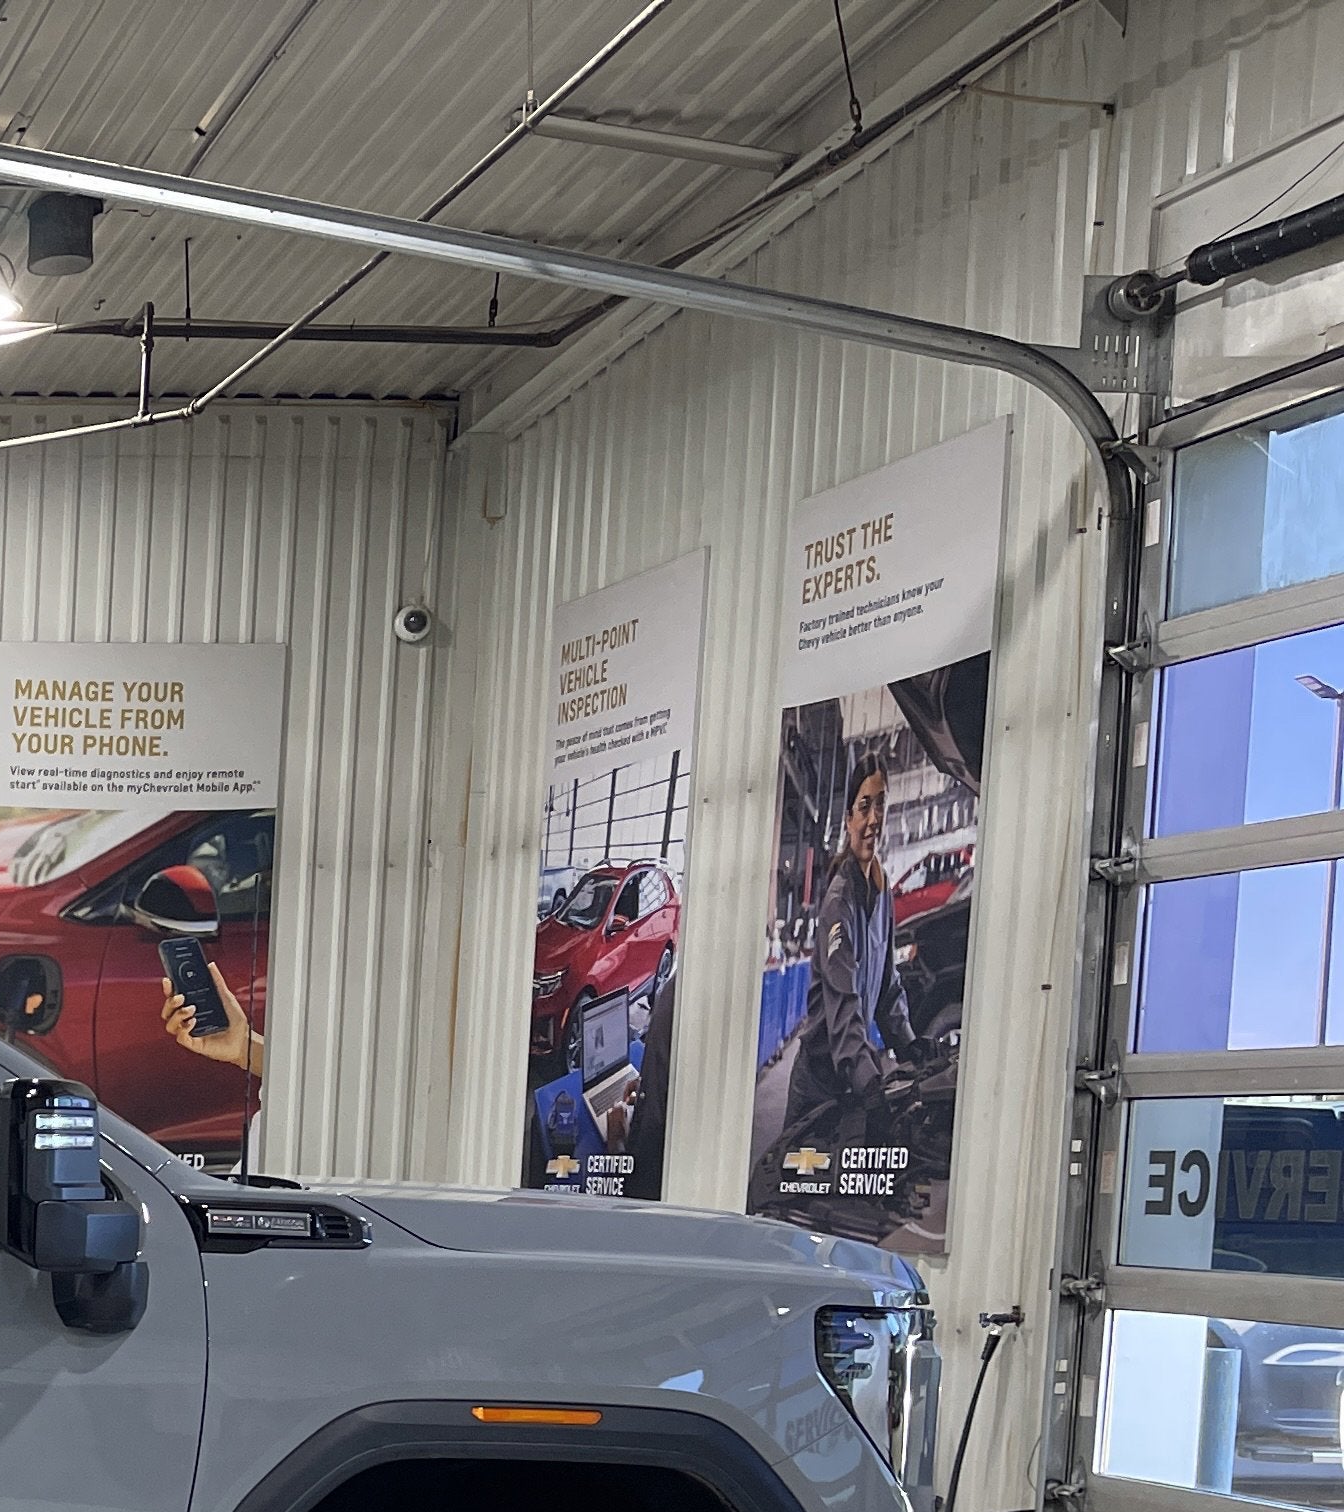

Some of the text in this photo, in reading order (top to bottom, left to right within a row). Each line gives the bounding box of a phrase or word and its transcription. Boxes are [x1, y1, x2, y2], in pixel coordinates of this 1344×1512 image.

[805, 513, 893, 569] TRUST THE
[802, 555, 880, 604] EXPERTS.
[799, 578, 944, 633] Factory trained technicians know your
[798, 605, 923, 650] Chevy vehicle better than anyone.
[560, 619, 639, 667] MULTI-POINT
[559, 659, 608, 696] VEHICLE
[15, 679, 184, 703] MANAGE YOUR
[558, 683, 627, 726] INSPECTION
[13, 705, 185, 730] VEHICLE FROM
[12, 732, 169, 757] YOUR PHONE.
[10, 765, 244, 781] View real-time diagnostics and enjoy remote
[42, 781, 88, 791] available
[91, 783, 103, 792] on
[107, 782, 124, 792] the
[127, 782, 193, 794] myChevrolet
[196, 782, 229, 792] Mobile
[587, 1155, 634, 1173] CERTIFIED
[841, 1147, 909, 1169] CERTIFIED
[586, 1176, 625, 1195] SERVICE
[779, 1182, 831, 1194] CHEVROLET
[839, 1173, 895, 1195] SERVICE
